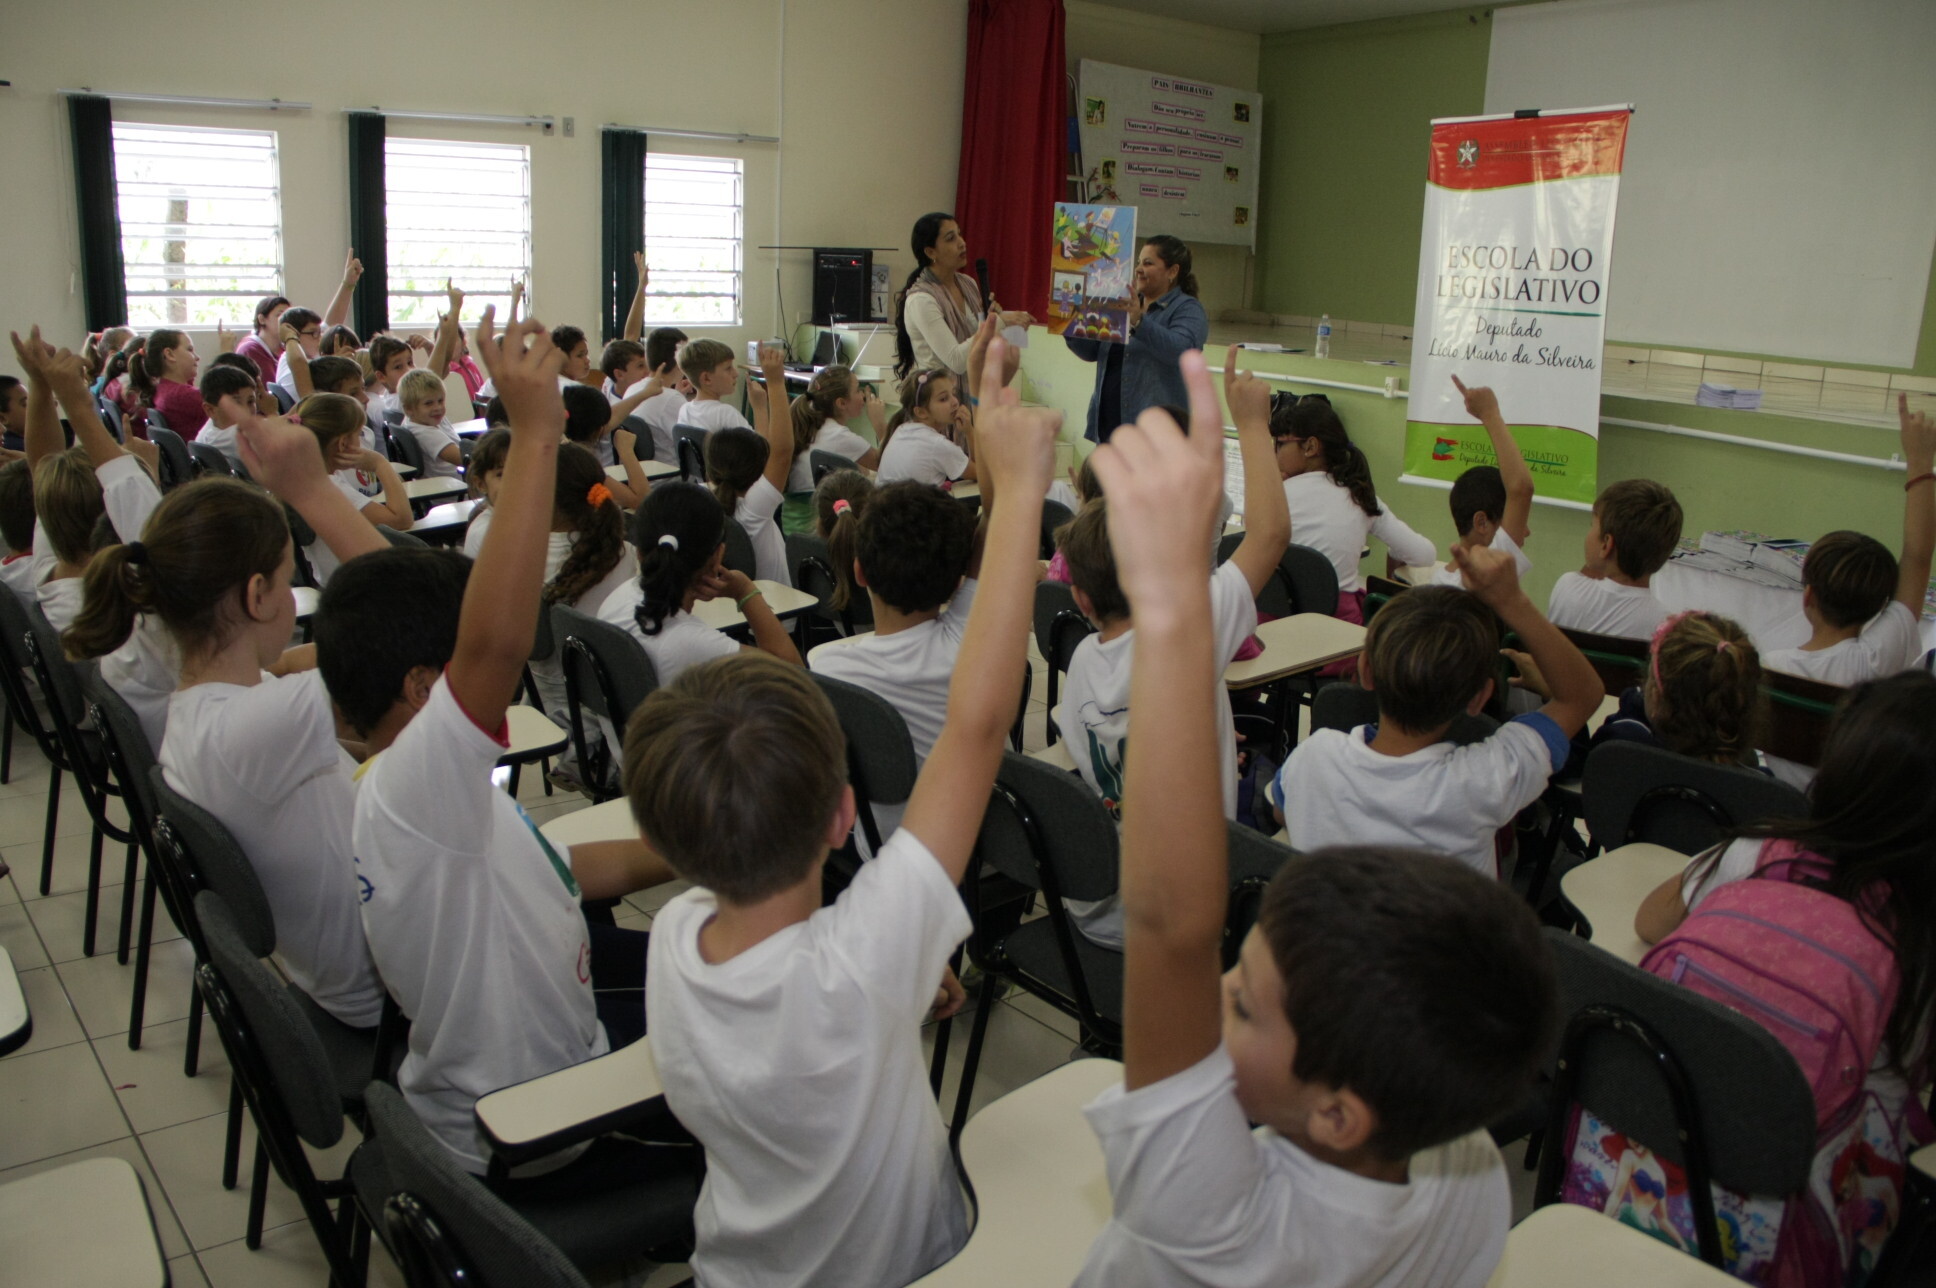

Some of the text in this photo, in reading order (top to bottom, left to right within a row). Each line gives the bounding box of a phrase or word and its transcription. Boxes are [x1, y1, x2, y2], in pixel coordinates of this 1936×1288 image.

[1448, 246, 1593, 273] ESCOLA DO
[1437, 275, 1600, 305] LEGISLATIVO
[1476, 315, 1542, 345] Deputado
[1461, 343, 1507, 362] Mauro
[1512, 344, 1532, 365] da
[1535, 346, 1596, 370] Silveira
[1460, 440, 1493, 453] ESCOLA
